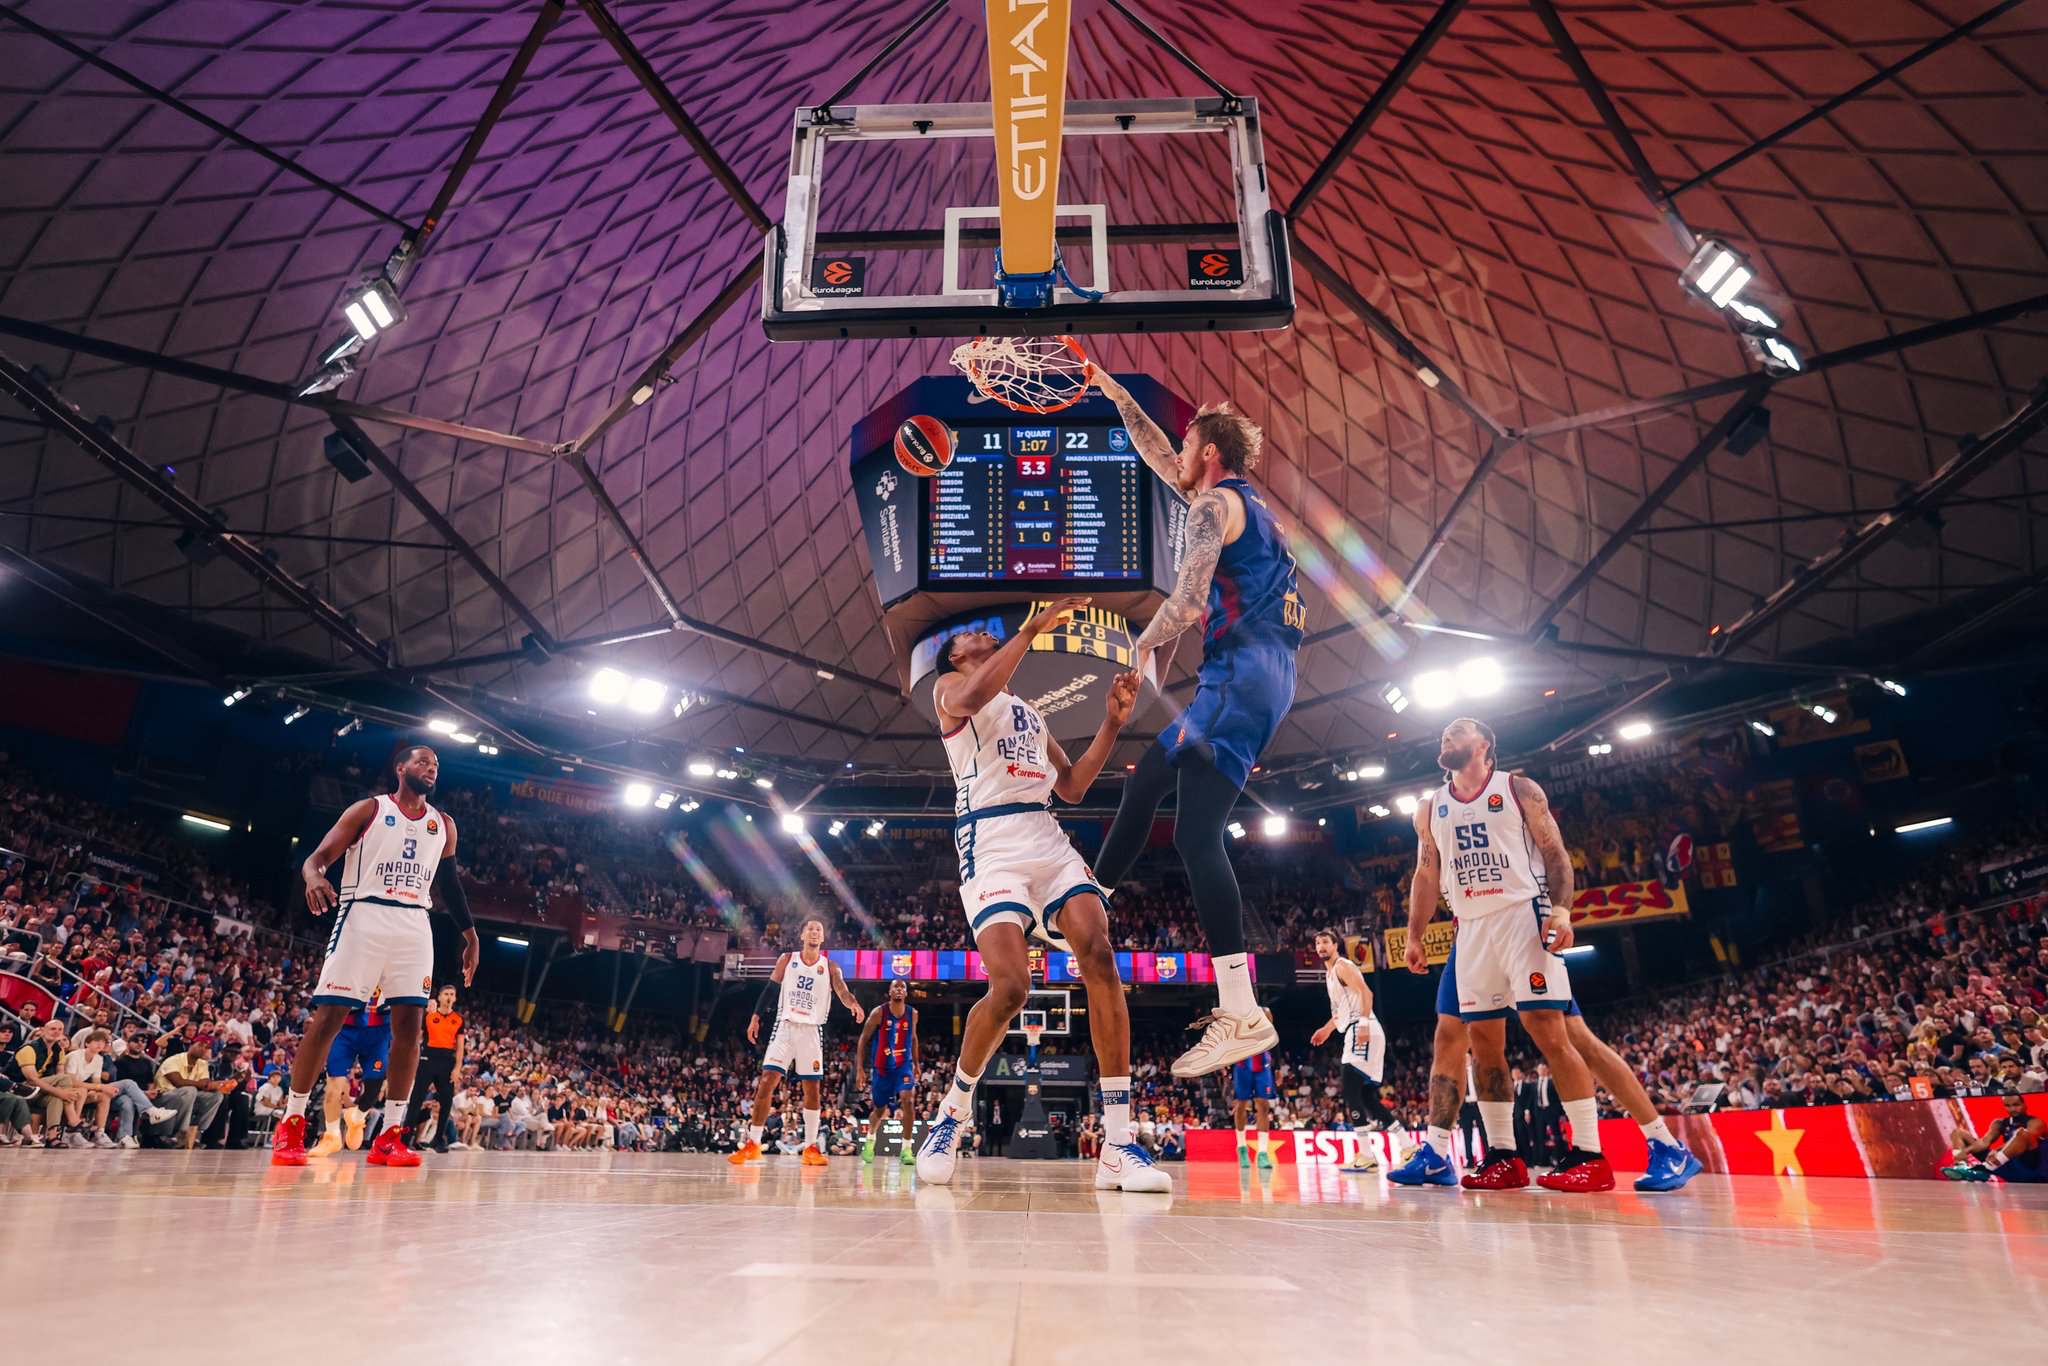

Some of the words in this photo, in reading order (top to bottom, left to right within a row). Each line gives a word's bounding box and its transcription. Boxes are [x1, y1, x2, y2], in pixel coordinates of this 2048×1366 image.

[1009, 0, 1049, 201] ETIHA
[812, 286, 862, 294] EuroLeague
[1190, 278, 1242, 287] EuroLeague
[983, 433, 1002, 450] 11
[1024, 430, 1052, 438] QUART
[1065, 432, 1089, 448] 22
[1020, 440, 1048, 452] 1:07
[1021, 461, 1046, 476] 3.3
[1017, 501, 1026, 511] 4
[1043, 501, 1050, 511] 1
[1168, 500, 1179, 548] Sanitària
[880, 508, 891, 557] Sanitària
[888, 504, 902, 573] Assistència
[1018, 532, 1025, 542] 1
[1042, 532, 1051, 542] 0
[1174, 503, 1187, 573] Assistència
[1066, 621, 1106, 640] FCB
[1004, 748, 1038, 765] EFE
[1455, 822, 1490, 851] 55
[402, 838, 417, 860] 3
[376, 862, 431, 881] ANADOLU
[1458, 868, 1502, 886] EFES
[384, 874, 422, 890] EFES
[1473, 887, 1504, 898] corendon
[796, 975, 814, 991] 32
[789, 990, 818, 1005] NADOL
[790, 999, 813, 1010] EFES
[996, 1058, 1011, 1076] A
[1916, 1082, 1928, 1098] 5
